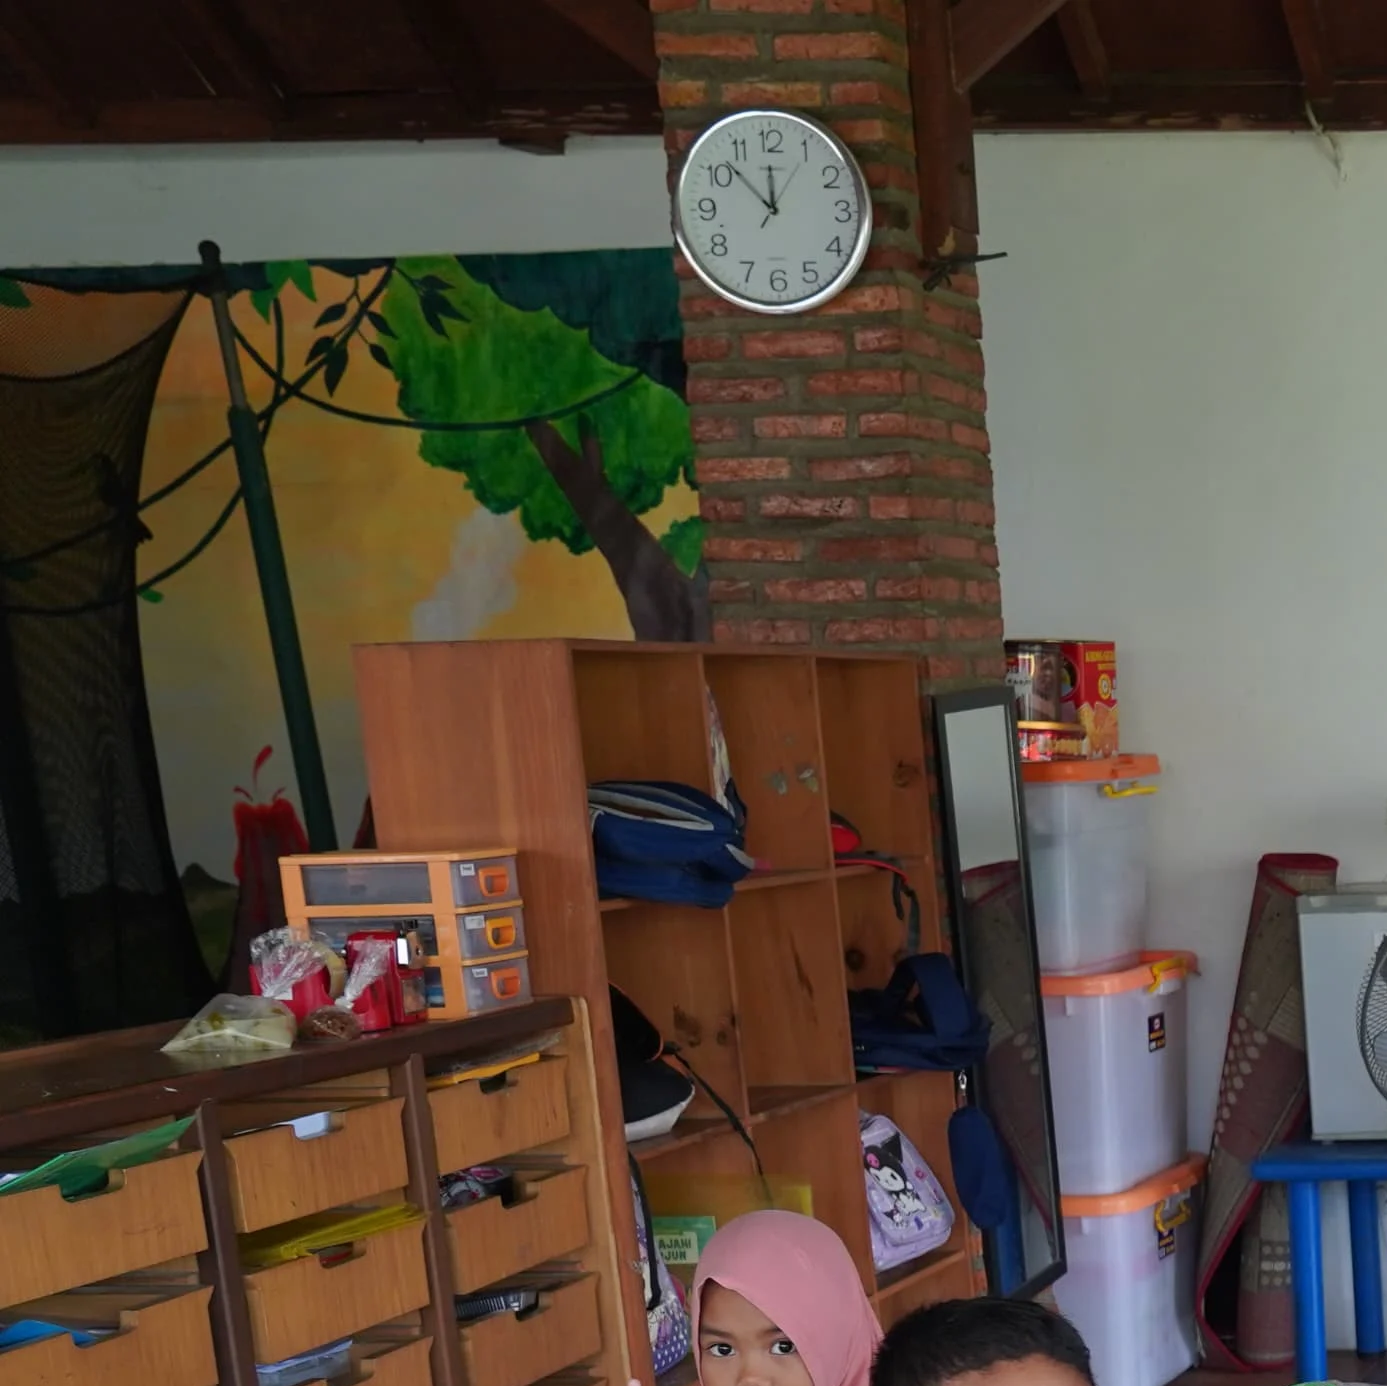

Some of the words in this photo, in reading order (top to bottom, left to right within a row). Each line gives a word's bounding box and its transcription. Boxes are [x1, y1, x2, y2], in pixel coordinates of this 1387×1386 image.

[731, 138, 747, 162] 11
[758, 129, 784, 153] 12
[801, 139, 808, 162] 1
[707, 163, 733, 187] 10
[822, 165, 840, 189] 2
[698, 198, 717, 221] 9
[834, 200, 852, 223] 3
[711, 234, 728, 256] 8
[825, 236, 843, 257] 4
[739, 261, 755, 283] 7
[769, 269, 788, 292] 6
[802, 261, 819, 283] 5
